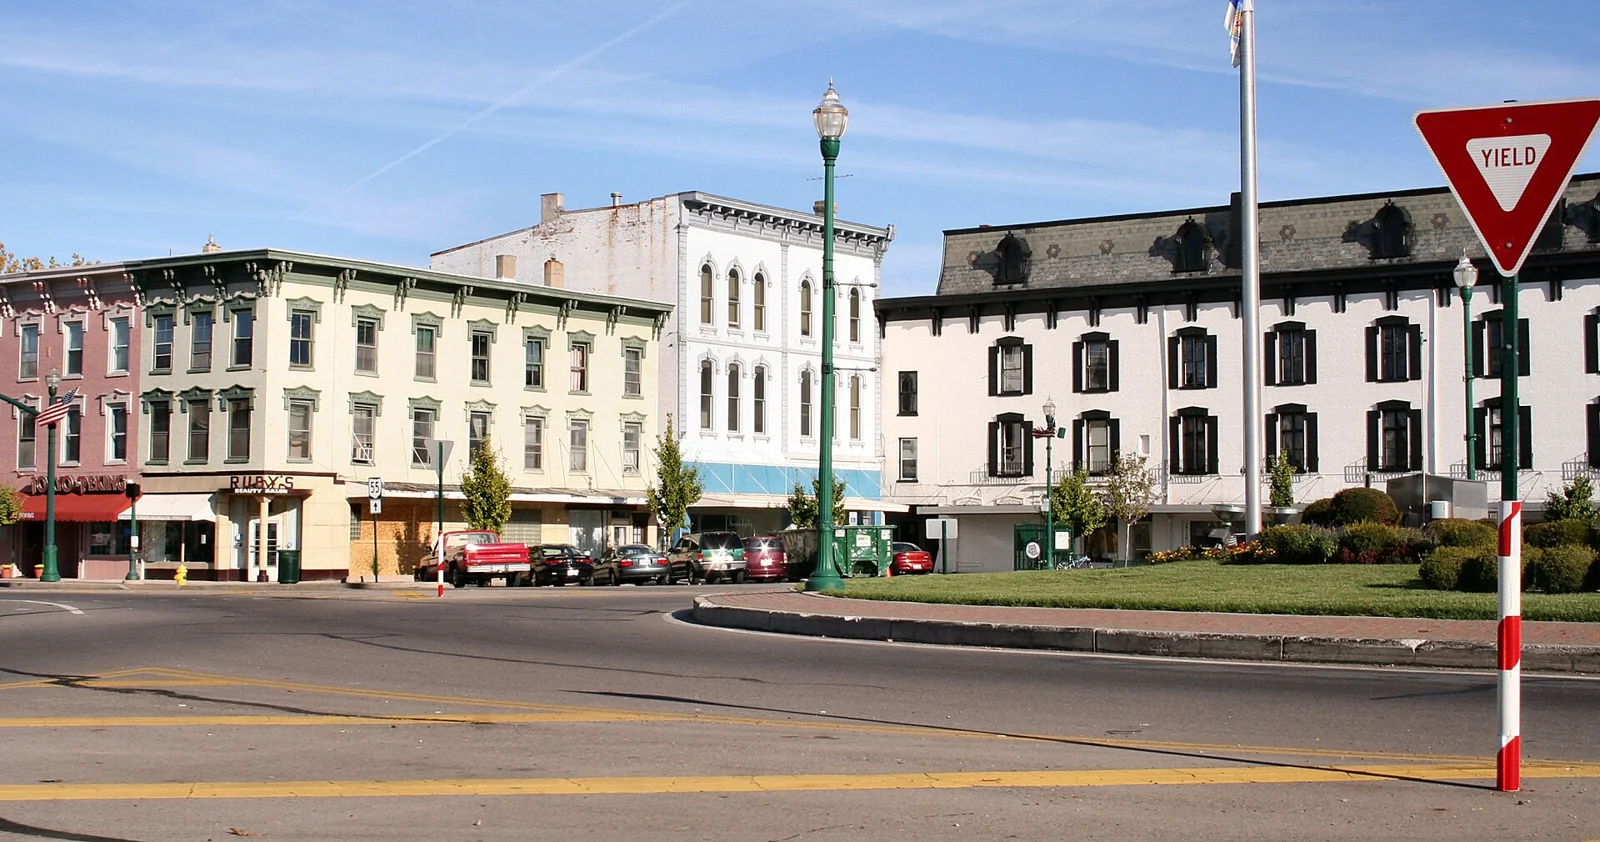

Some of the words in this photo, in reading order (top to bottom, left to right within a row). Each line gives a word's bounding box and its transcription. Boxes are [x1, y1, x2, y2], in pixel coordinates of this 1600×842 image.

[1481, 146, 1536, 168] YIELD
[30, 474, 127, 495] TOYO-PEKING
[230, 475, 294, 489] RUBY'S
[370, 481, 380, 494] 55
